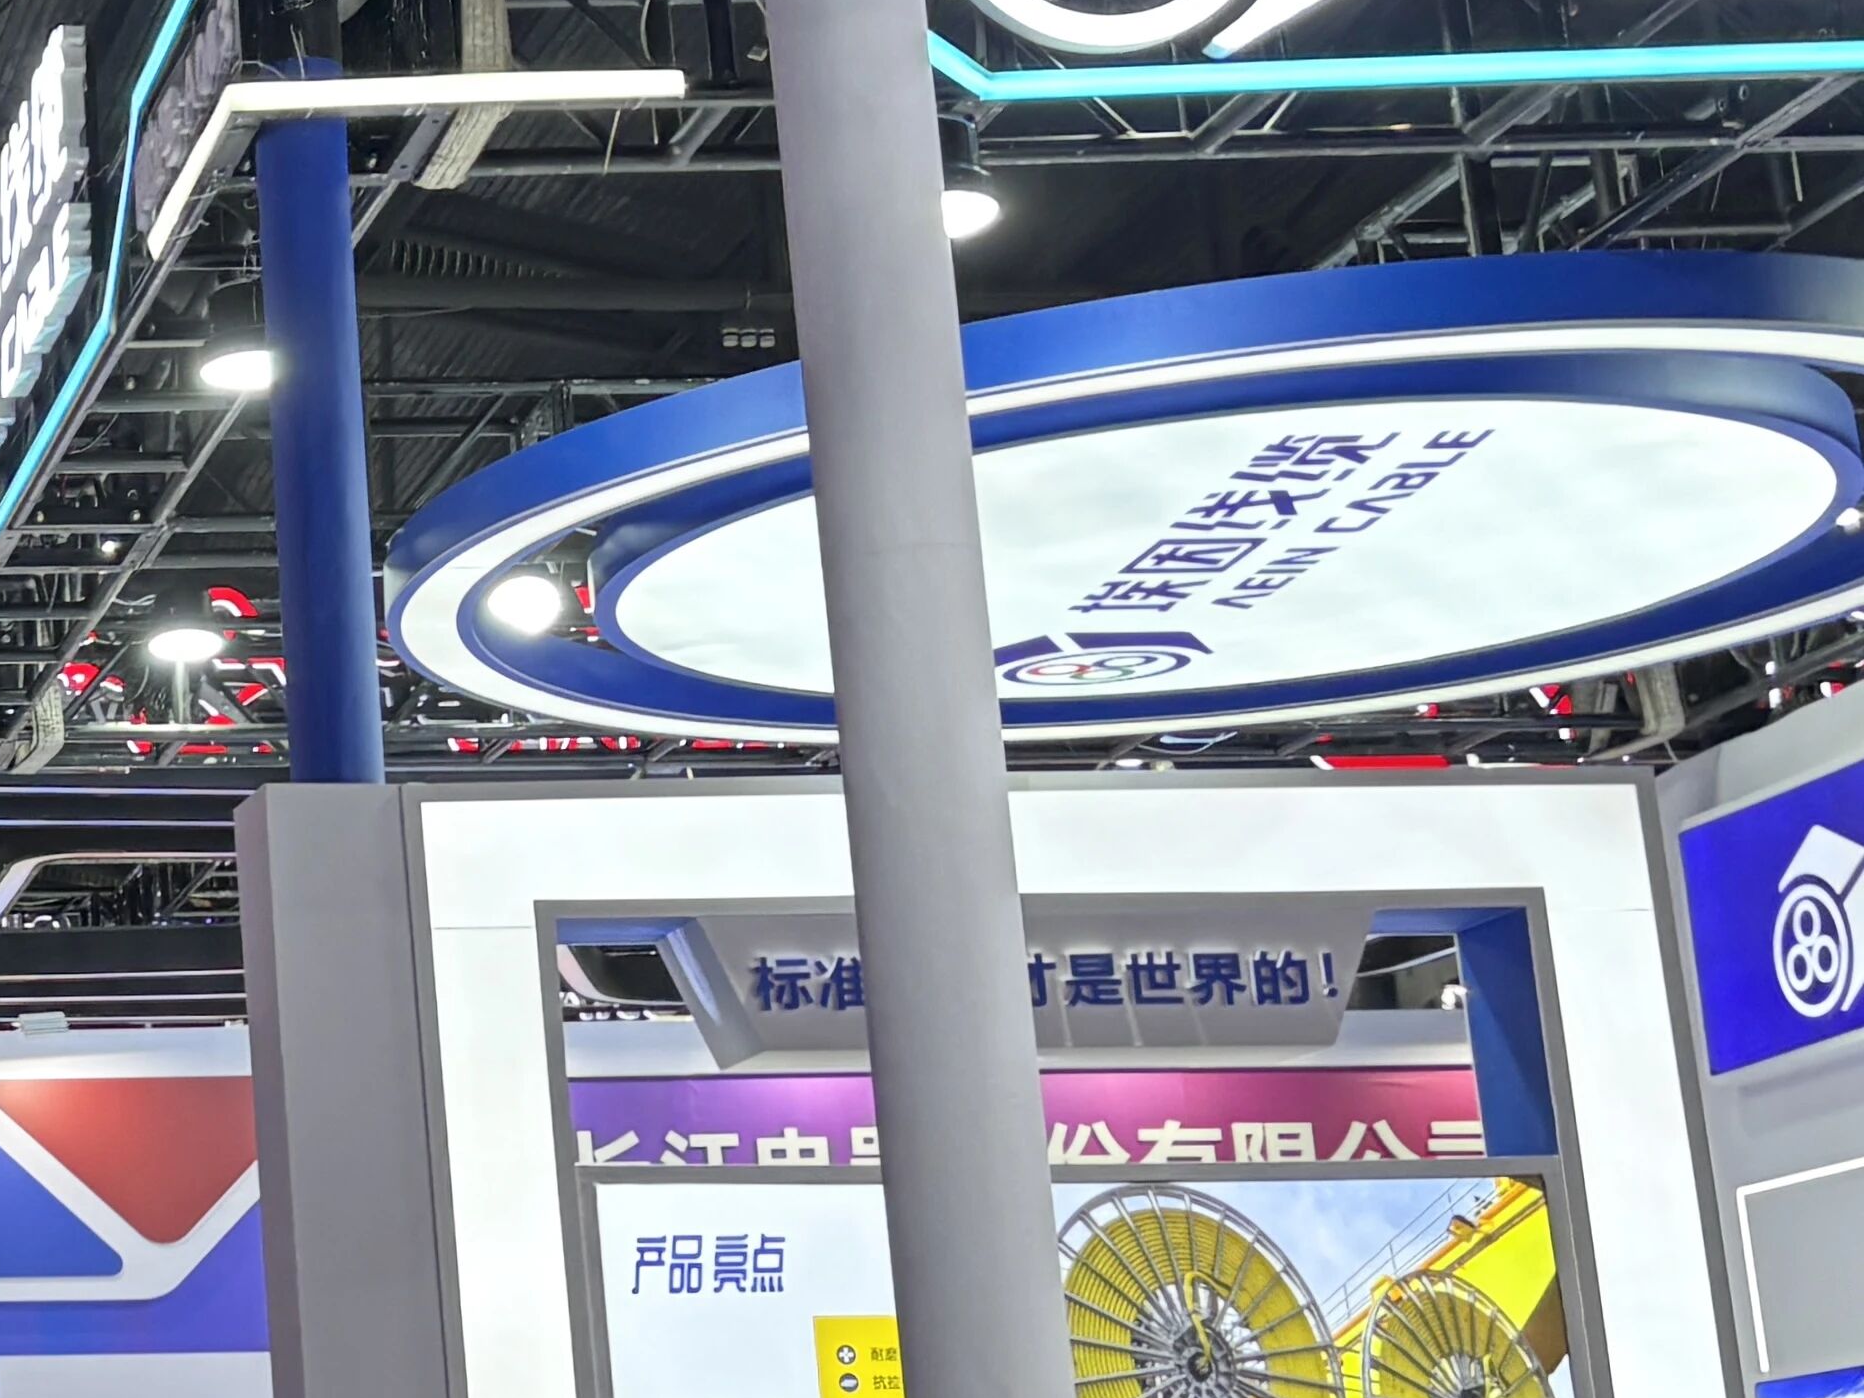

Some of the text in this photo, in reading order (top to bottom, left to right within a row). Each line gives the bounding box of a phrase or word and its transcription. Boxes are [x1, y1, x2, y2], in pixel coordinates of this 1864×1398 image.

[753, 950, 1338, 1012] 标准才是世界的!
[632, 1234, 786, 1296] 产品亮点
